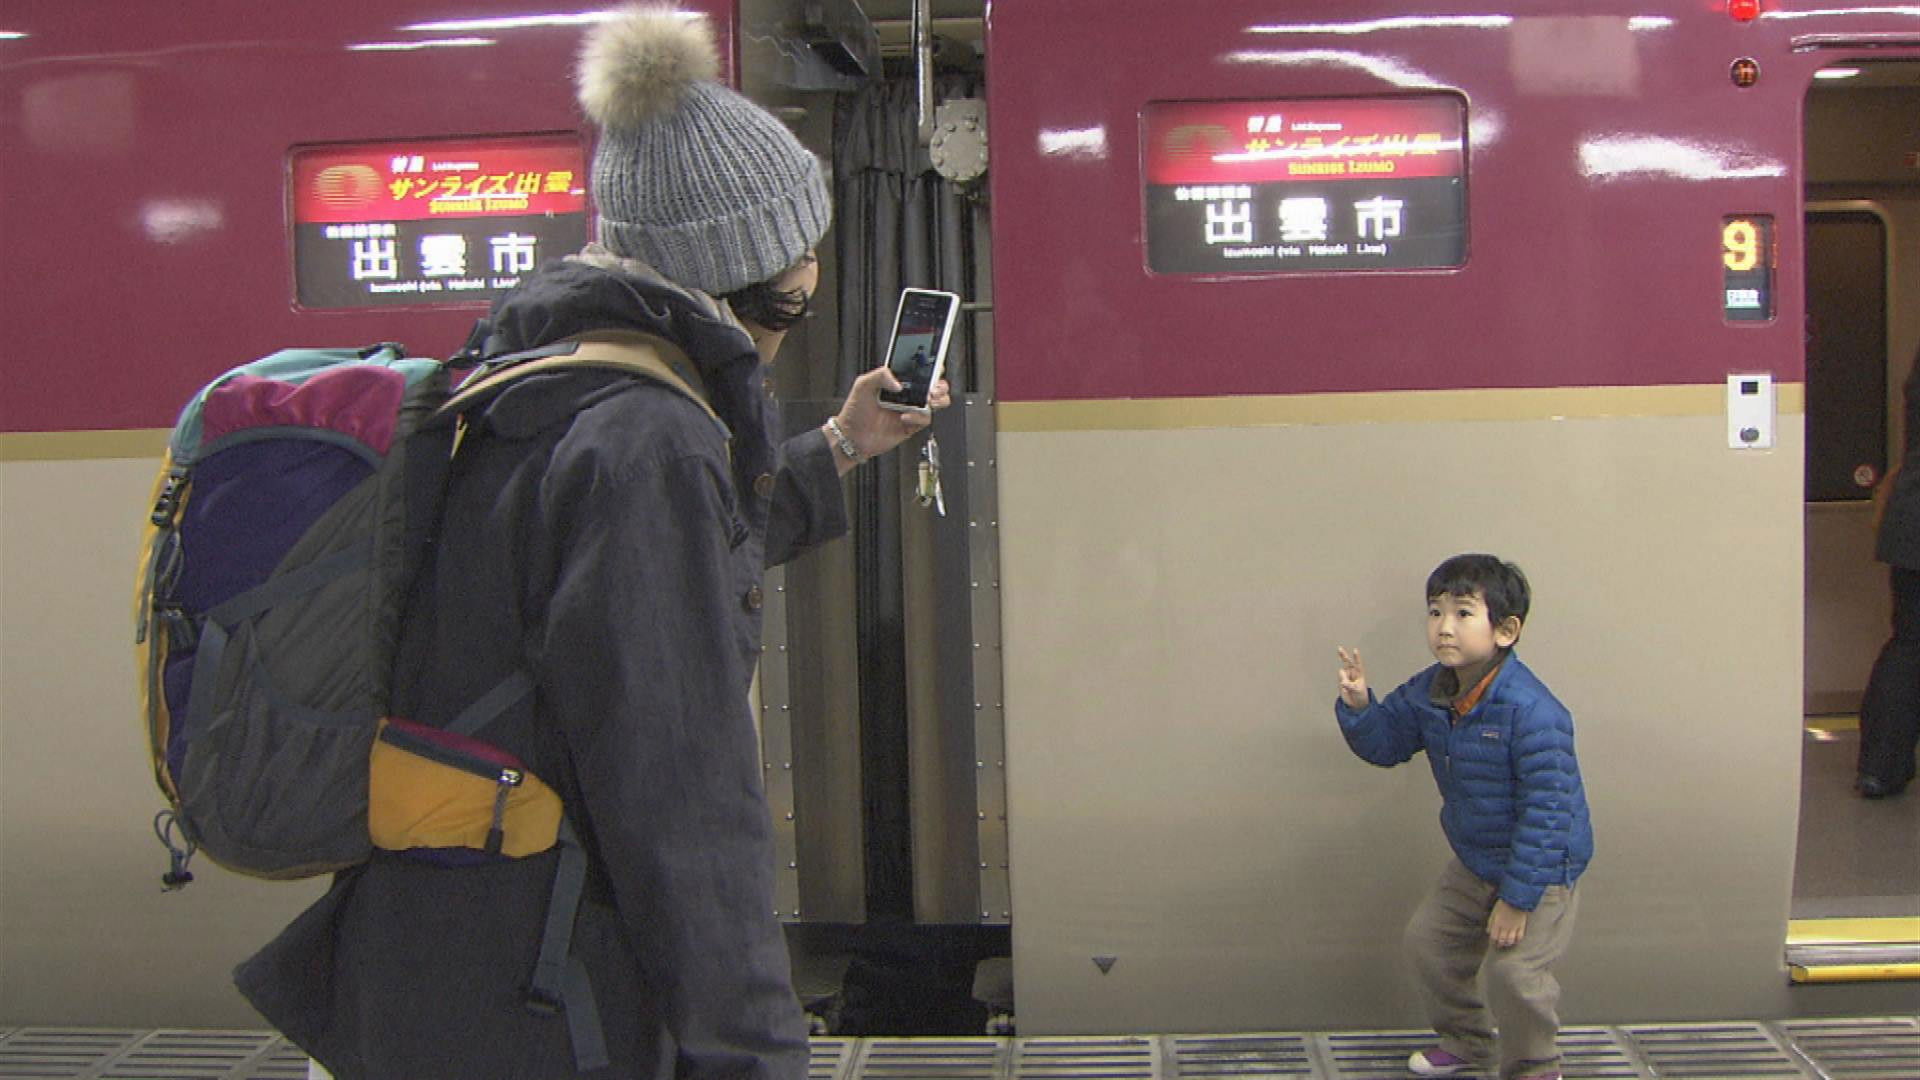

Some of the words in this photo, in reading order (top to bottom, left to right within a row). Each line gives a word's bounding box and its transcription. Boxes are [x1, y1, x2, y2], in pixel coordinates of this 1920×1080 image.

[1205, 196, 1403, 245] 出雲市
[353, 232, 537, 280] 出雲市
[1722, 220, 1757, 271] 9
